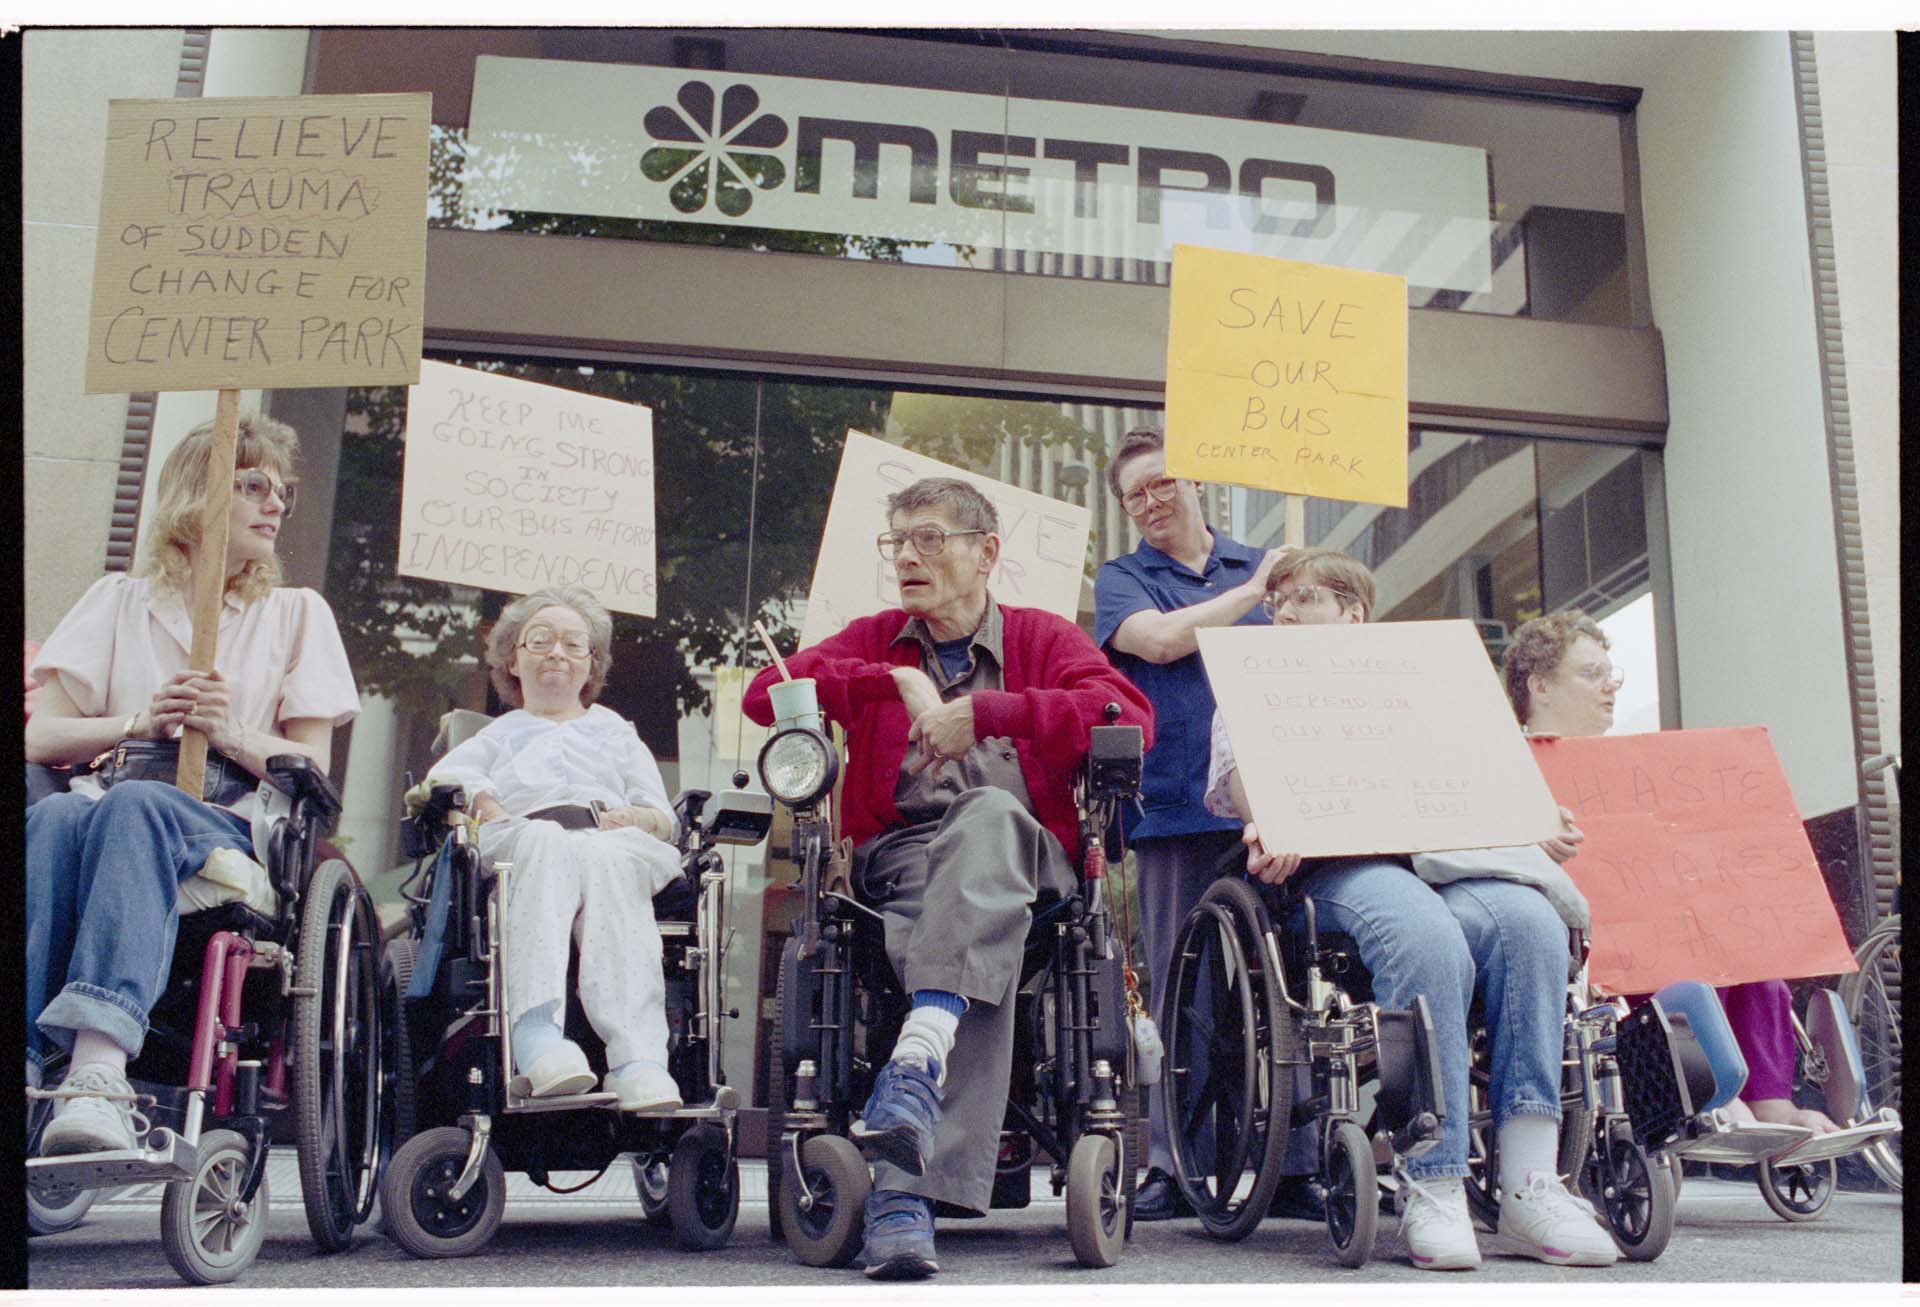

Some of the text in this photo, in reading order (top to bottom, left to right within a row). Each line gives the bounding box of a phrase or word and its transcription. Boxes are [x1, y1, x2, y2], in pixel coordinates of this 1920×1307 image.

[146, 116, 408, 160] RELIEVE
[173, 173, 371, 215] TRAUMA
[794, 115, 1337, 239] METRO
[120, 224, 349, 258] OF SUDDEN
[129, 264, 410, 307] CHANGE FOR
[1217, 287, 1364, 339] SAVE
[104, 306, 409, 372] CENTER PARK
[1251, 360, 1339, 393] OUR
[448, 388, 603, 435] KEEP ME
[1241, 396, 1331, 436] BUS
[432, 422, 651, 477] GOING STRONG
[1196, 442, 1365, 479] CENTER PARK
[464, 469, 618, 514] SOCIETY
[519, 466, 550, 481] IN
[421, 500, 505, 531] OUR
[512, 509, 573, 537] BUS
[406, 532, 656, 598] INDEPENDENCE
[1572, 765, 1770, 814] HASTE
[1600, 846, 1803, 895] MAKES
